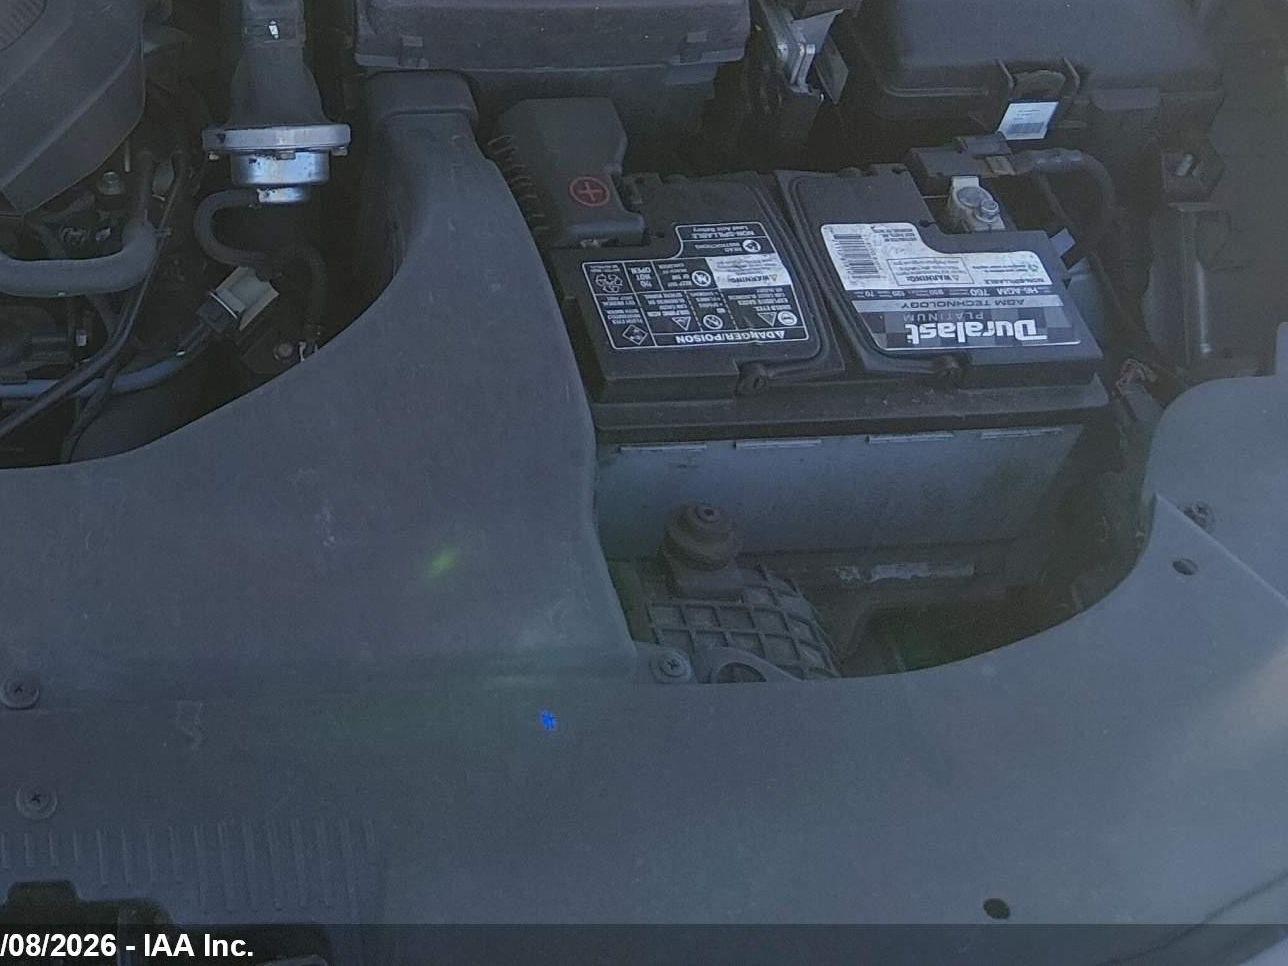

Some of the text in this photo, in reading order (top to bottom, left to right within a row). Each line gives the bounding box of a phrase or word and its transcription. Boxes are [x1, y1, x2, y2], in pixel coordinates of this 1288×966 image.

[902, 299, 991, 309] TECHNOLOGY
[903, 311, 984, 323] PLATINUM
[905, 318, 1049, 345] Duralast
